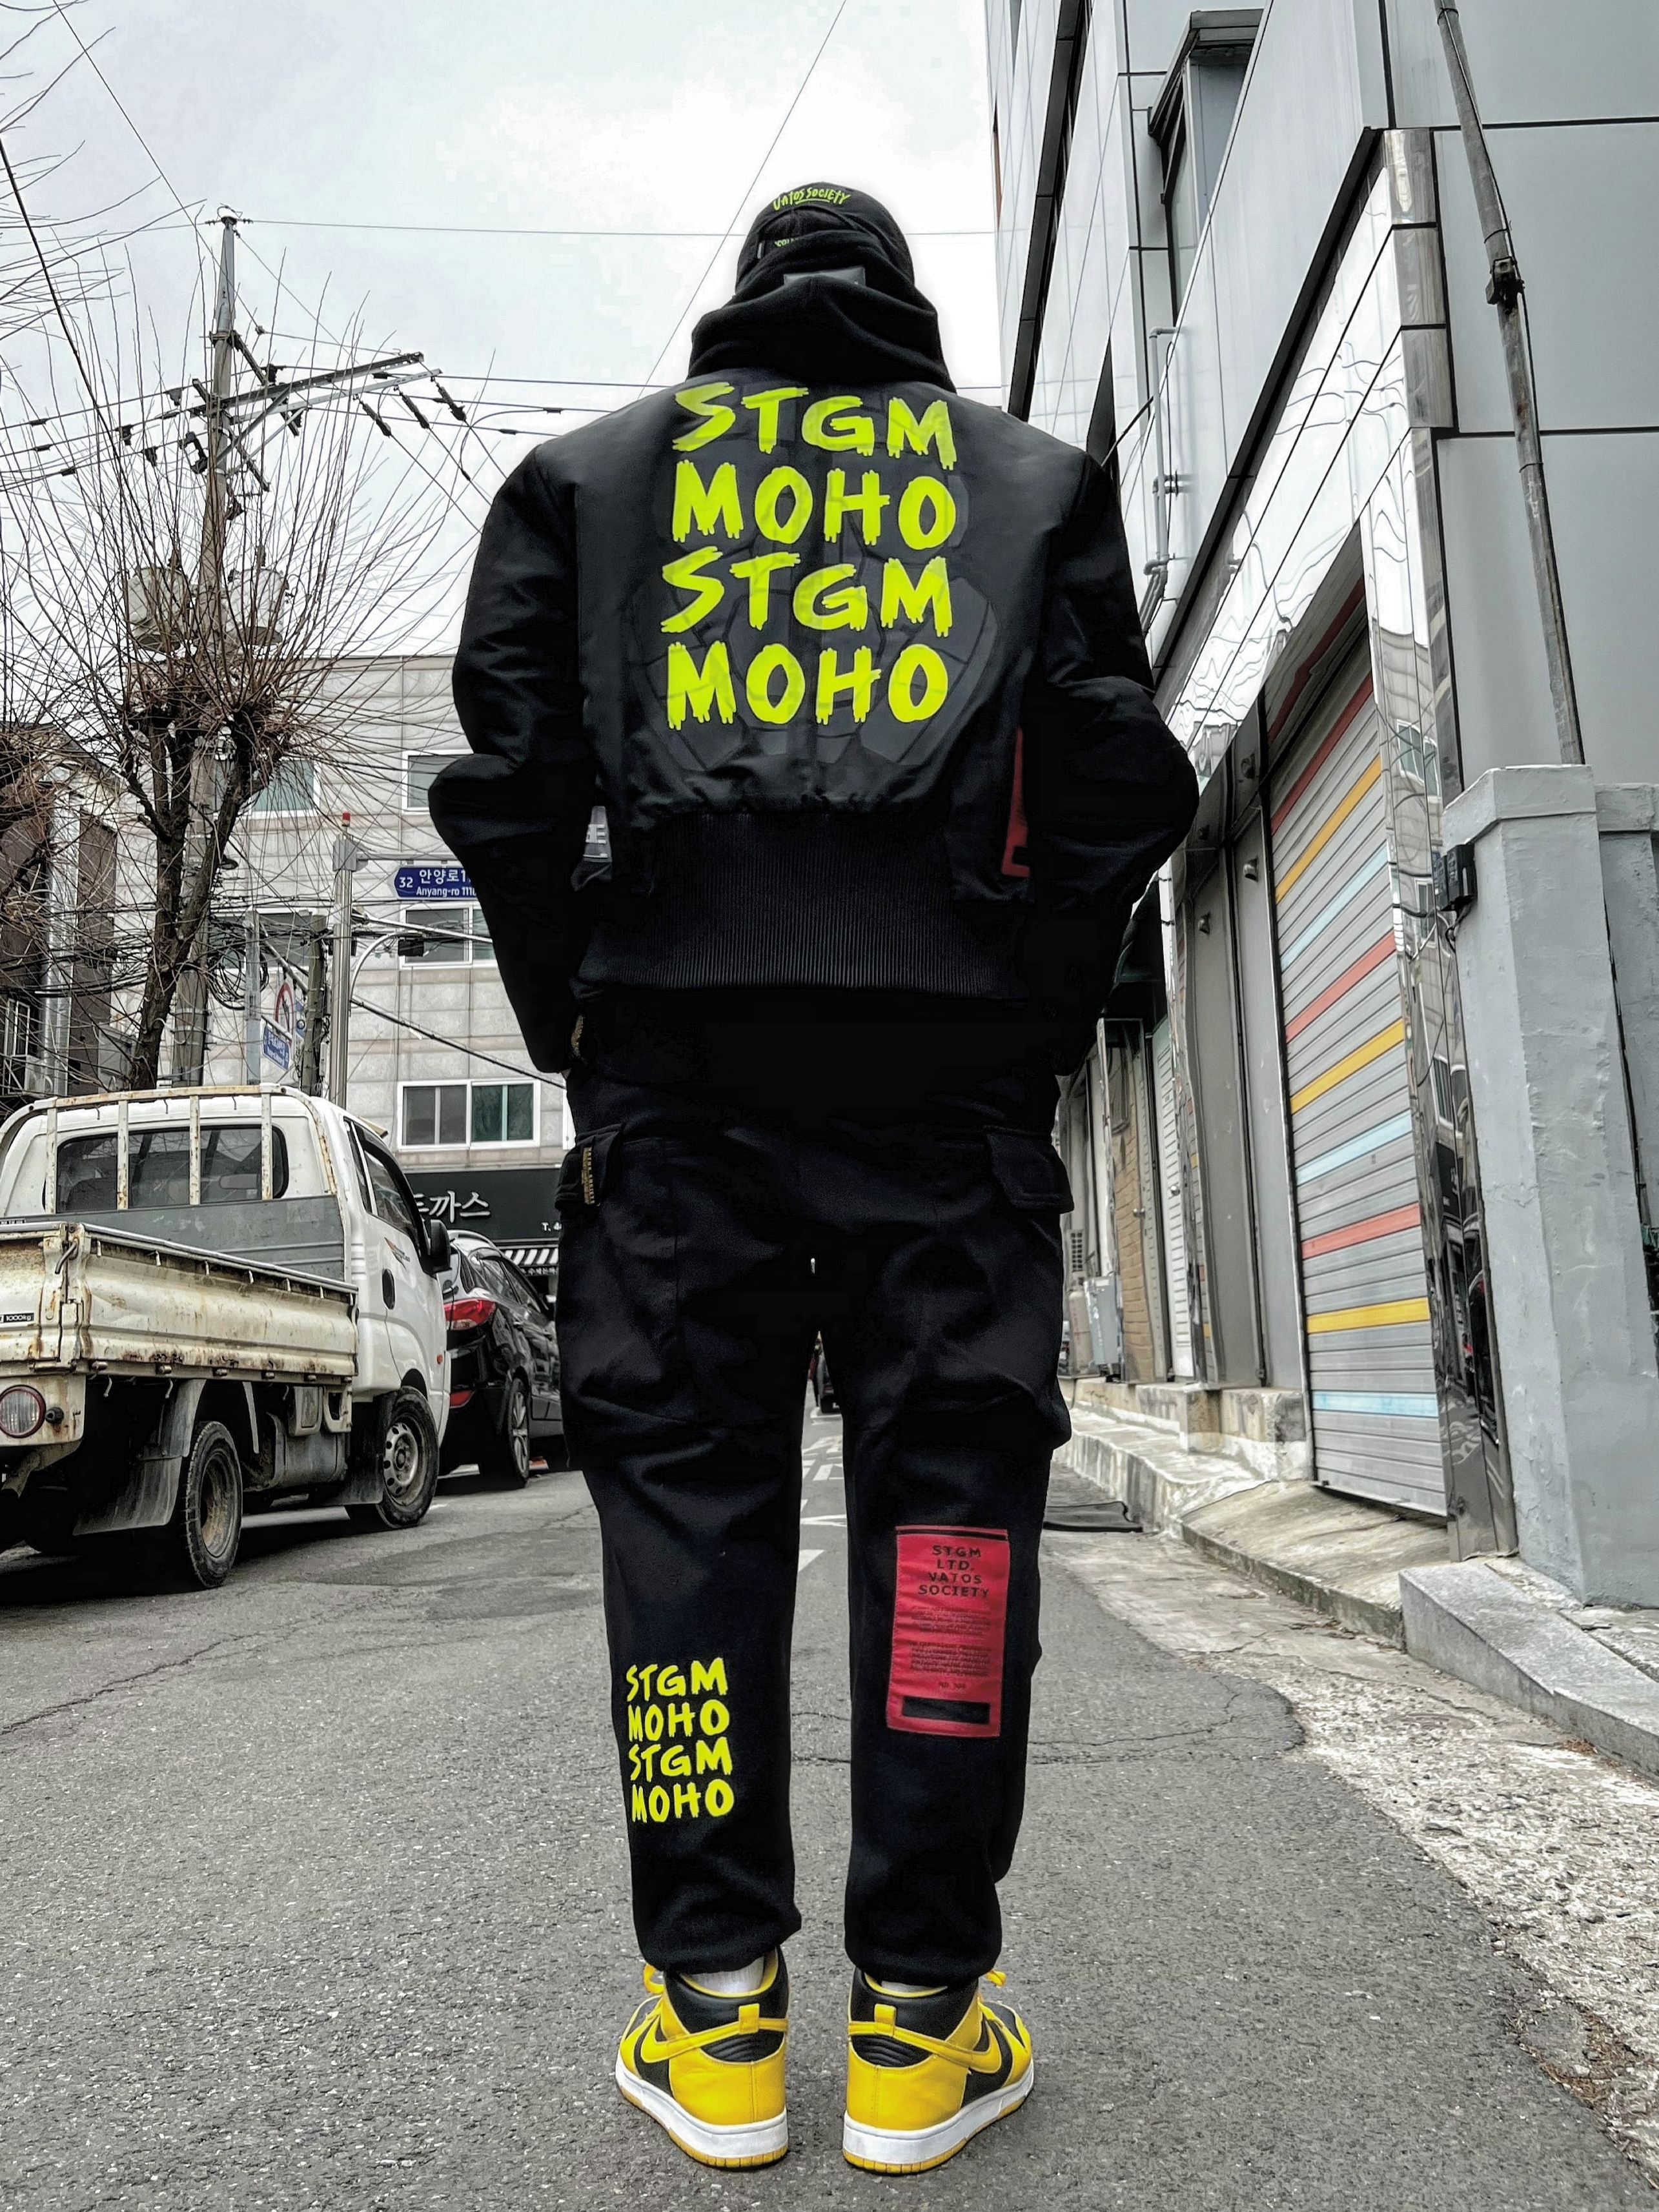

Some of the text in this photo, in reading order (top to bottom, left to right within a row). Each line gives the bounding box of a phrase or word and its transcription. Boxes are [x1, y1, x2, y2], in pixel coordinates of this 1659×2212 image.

[806, 187, 851, 205] SOCIETY
[673, 382, 957, 470] STGM
[673, 460, 957, 550] MOHO
[661, 546, 952, 637] STGM
[667, 642, 948, 729] MOHO
[399, 877, 413, 888] 32
[416, 886, 460, 898] Anyang-ro
[419, 869, 471, 885] 안양로1
[932, 1545, 981, 1558] STGM
[918, 1585, 988, 1598] SOCIETY
[928, 1572, 982, 1584] VATOS
[626, 1658, 728, 1702] STGM
[627, 1699, 730, 1741] MOHO
[628, 1736, 733, 1782] STGM
[631, 1778, 735, 1823] MOHO
